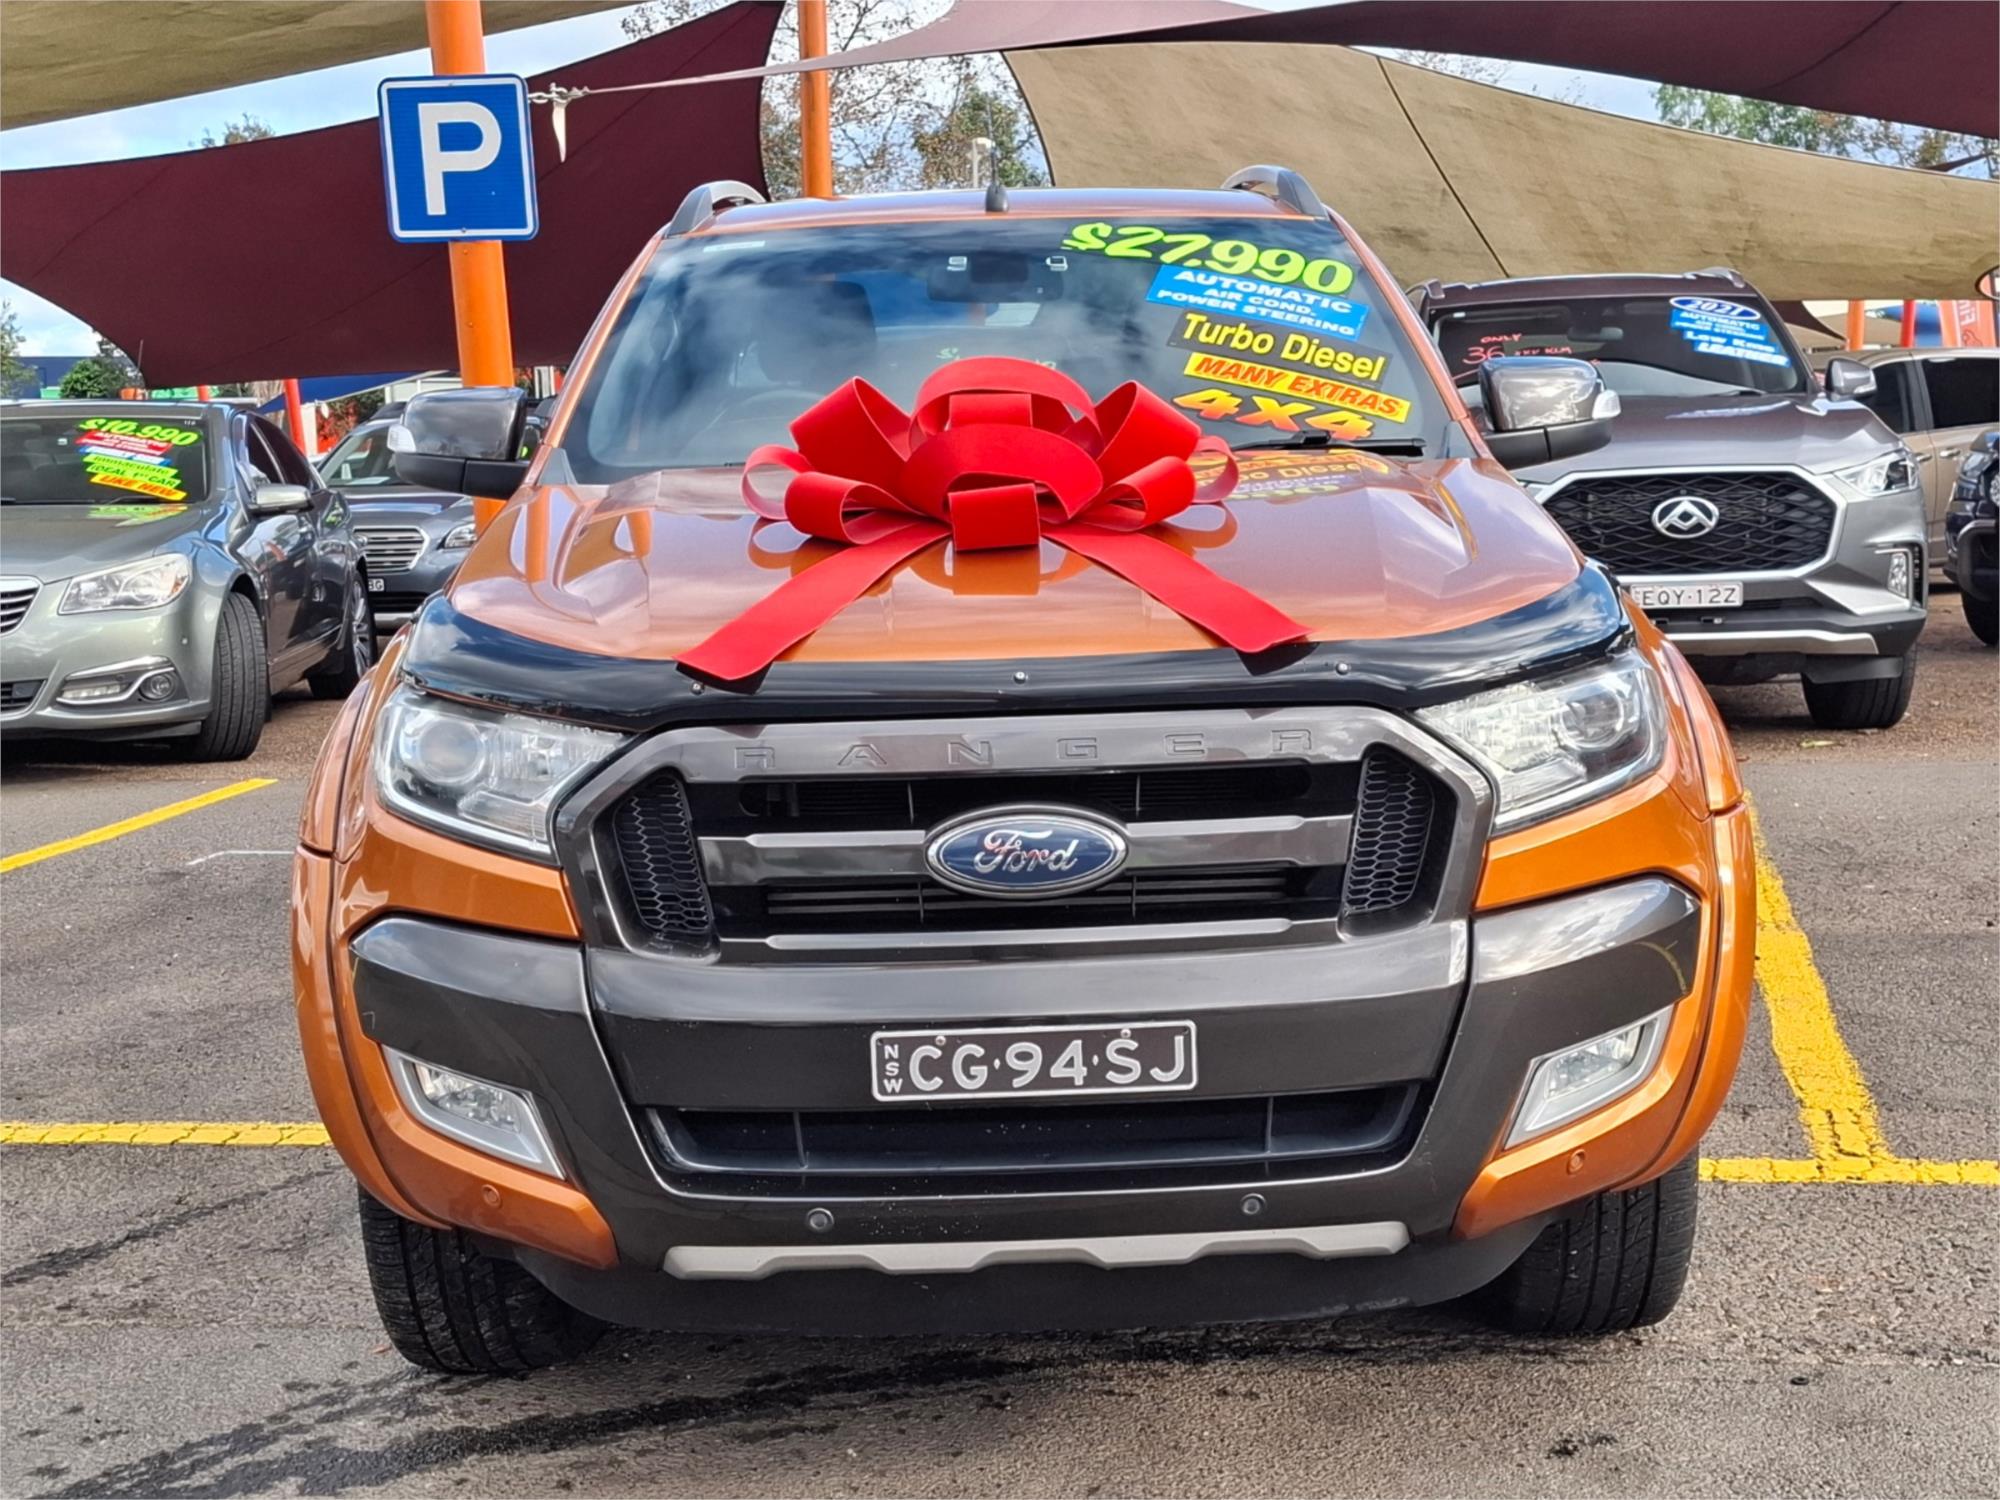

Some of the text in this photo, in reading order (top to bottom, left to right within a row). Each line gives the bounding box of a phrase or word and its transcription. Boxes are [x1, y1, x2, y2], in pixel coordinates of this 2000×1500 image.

[418, 101, 501, 217] P
[1157, 288, 1356, 336] POWER STEERING
[1174, 270, 1352, 314] AUTOMATIC
[1202, 287, 1316, 316] AIR COND.
[1686, 300, 1745, 317] 2021
[1679, 310, 1760, 331] AUTOMATIC
[1183, 312, 1387, 381] Turbo Diesel
[1194, 357, 1401, 415] MANY EXTRAS
[1173, 388, 1375, 439] 4X4
[733, 727, 1314, 770] RANGER
[973, 828, 1080, 874] Ford
[883, 1043, 903, 1095] NSW
